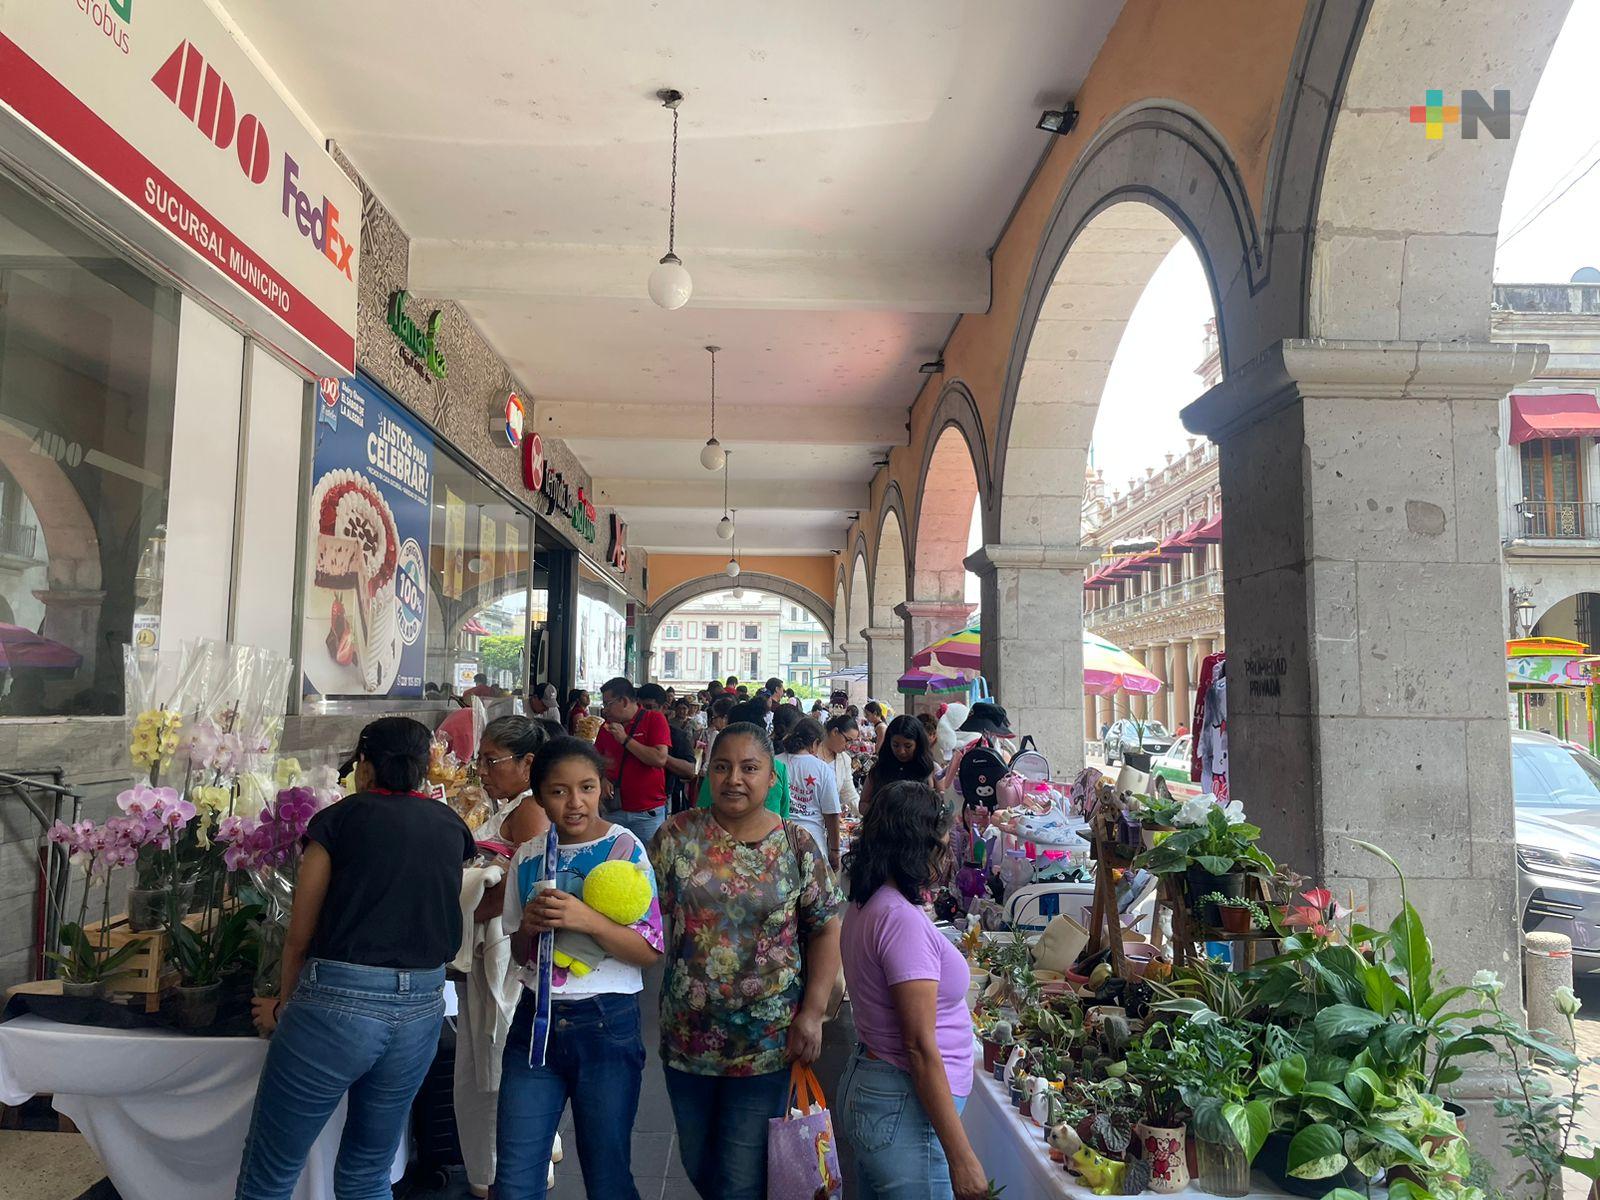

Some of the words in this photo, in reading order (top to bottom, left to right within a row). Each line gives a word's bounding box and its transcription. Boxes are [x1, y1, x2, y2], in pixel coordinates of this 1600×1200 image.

[150, 38, 270, 185] ADO
[144, 176, 226, 263] SUCURSAL
[229, 246, 291, 313] MUNICIPIO
[282, 152, 354, 282] FedEx
[30, 429, 82, 468] ADO
[367, 431, 430, 498] CELEBRAR!
[1249, 679, 1281, 697] PRIVADA
